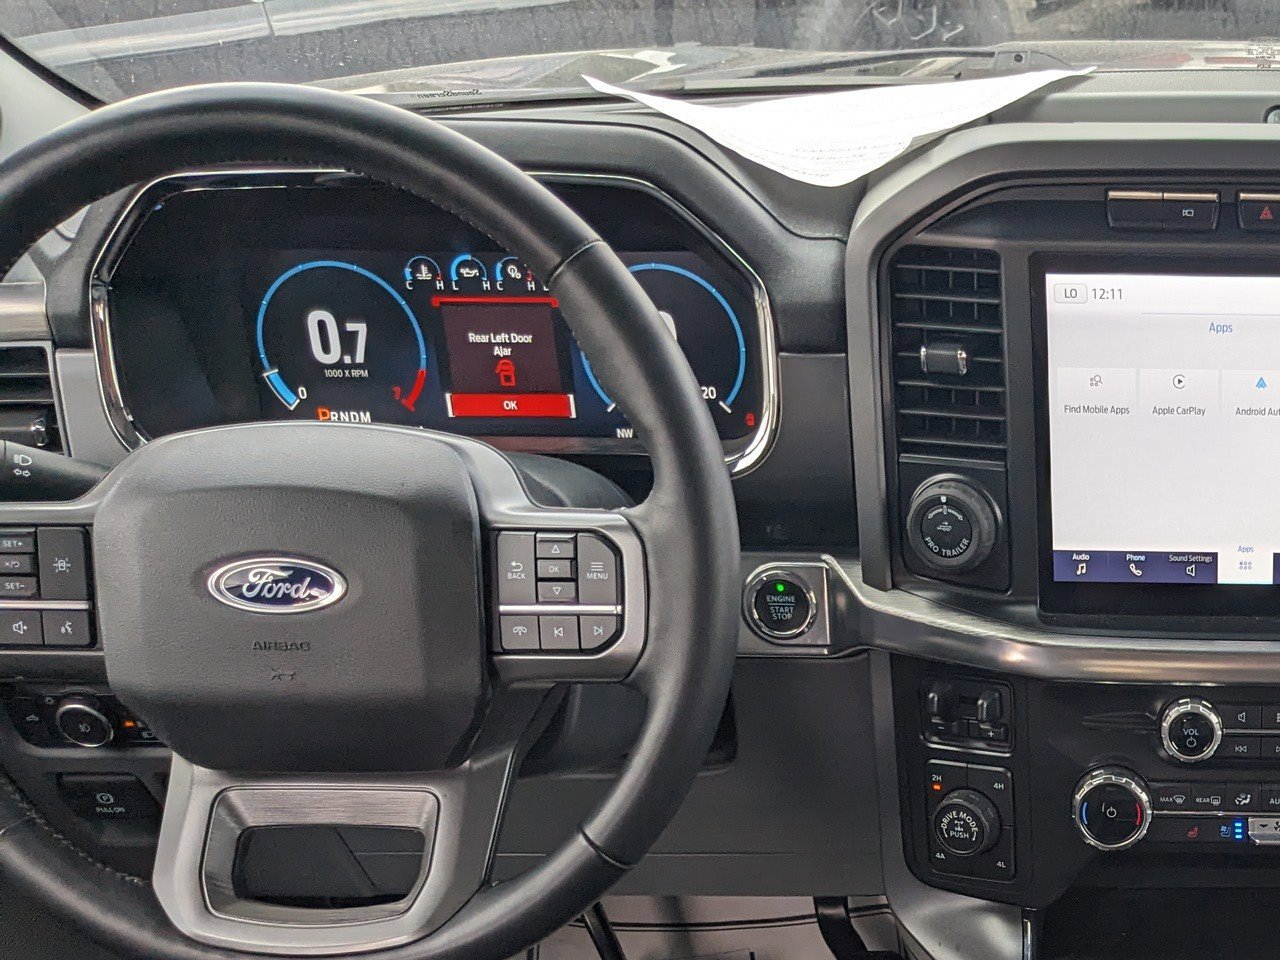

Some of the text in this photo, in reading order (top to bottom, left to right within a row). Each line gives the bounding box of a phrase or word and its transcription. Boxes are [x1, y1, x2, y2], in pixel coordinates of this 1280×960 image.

[406, 281, 413, 290] C
[436, 281, 444, 291] H
[452, 281, 459, 291] L
[483, 281, 491, 291] H
[527, 281, 535, 291] H
[1064, 288, 1123, 300] LO 12:11
[1208, 322, 1233, 335] Apps
[306, 309, 368, 365] 0.7
[468, 332, 533, 343] Rear Left Door
[494, 345, 512, 357] Ajar
[324, 369, 369, 378] 1000 X RPM
[298, 387, 307, 400] 0
[700, 386, 717, 399] 20
[503, 400, 518, 410] OK
[1064, 404, 1130, 416] Find Mobile Apps
[1152, 406, 1206, 416] Apple CarPlay
[1235, 407, 1266, 416] Android
[616, 428, 634, 438] NW
[924, 536, 970, 557] PRO TRAILER
[1237, 545, 1254, 554] Apps
[1072, 553, 1090, 561] Audio
[1126, 553, 1146, 562] Phone
[1168, 554, 1213, 563] Sound Settings
[549, 565, 560, 573] OK
[507, 571, 526, 580] BACK
[586, 571, 609, 580] MENU
[242, 568, 312, 600] Ford
[766, 595, 796, 603] ENGINE
[770, 606, 794, 614] START
[772, 613, 793, 621] STOP
[1183, 728, 1200, 736] VOL
[931, 774, 942, 782] 2H
[940, 811, 979, 832] DRIVE MODE
[950, 831, 970, 839] PUSH
